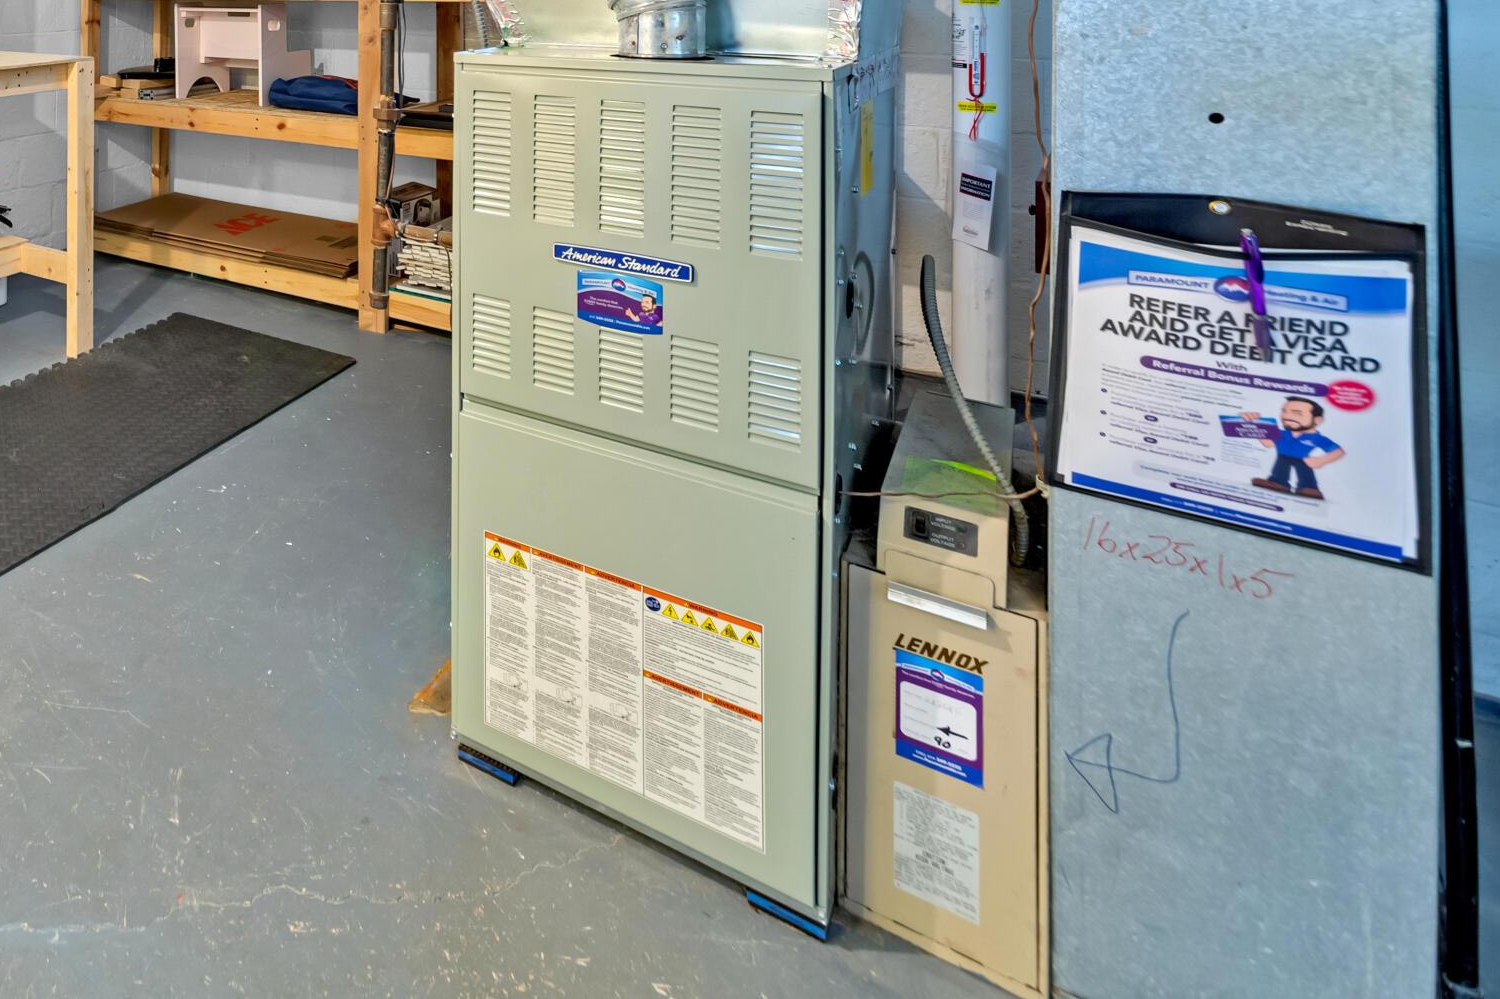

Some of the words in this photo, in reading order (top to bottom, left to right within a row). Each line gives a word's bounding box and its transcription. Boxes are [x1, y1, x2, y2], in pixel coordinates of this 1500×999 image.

[561, 247, 616, 268] American
[618, 257, 681, 279] Standard
[1134, 273, 1210, 290] PARAMOUNT
[1129, 292, 1212, 323] REFER
[1216, 310, 1238, 327] A
[1128, 309, 1189, 334] AND
[1197, 322, 1252, 344] GET
[1283, 333, 1350, 354] VISA
[1099, 317, 1201, 351] AWARD
[1298, 348, 1382, 374] CARD
[1152, 358, 1205, 378] Referral
[1208, 369, 1251, 386] Bonus
[1253, 376, 1316, 395] Rewards
[1215, 359, 1248, 373] With
[930, 538, 956, 548] VOLTAGE
[931, 532, 954, 543] OUTPUT
[539, 550, 583, 571] AVERTISSEMENT
[596, 570, 635, 588] ADVERTENCIA
[688, 603, 719, 617] WARNING
[893, 632, 989, 674] LENNOX
[651, 674, 700, 696] AVERTISSEMENT
[713, 698, 759, 719] ADVERTENCIA
